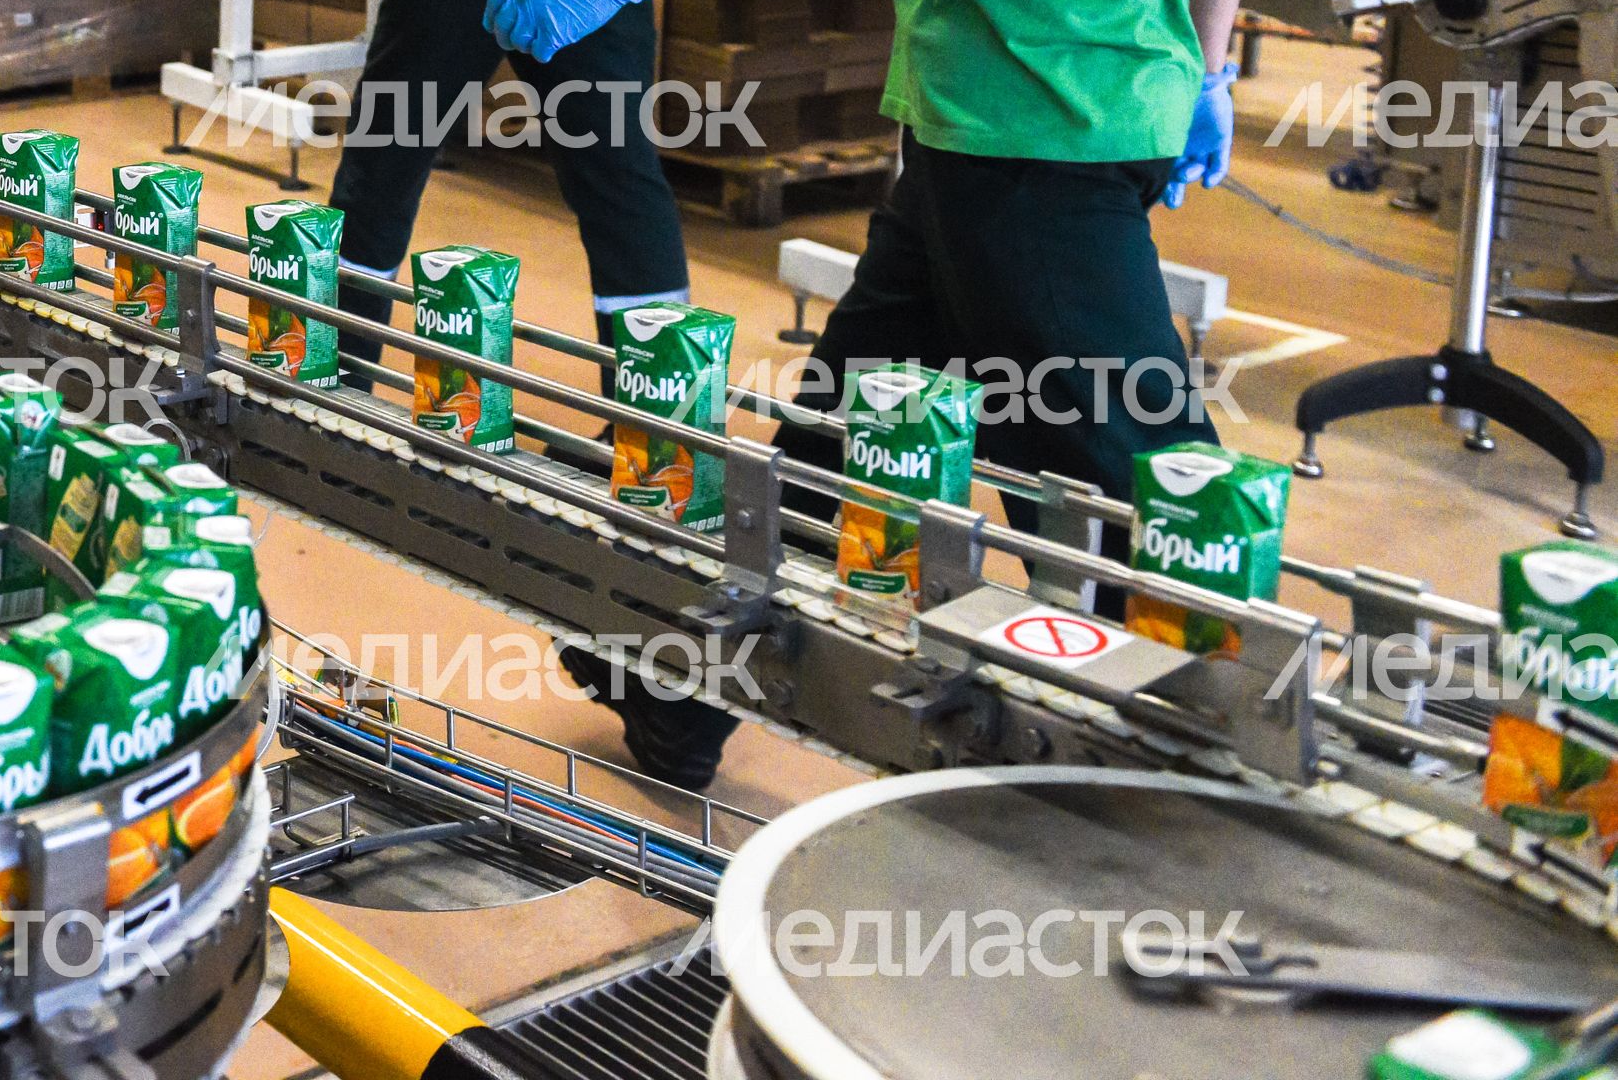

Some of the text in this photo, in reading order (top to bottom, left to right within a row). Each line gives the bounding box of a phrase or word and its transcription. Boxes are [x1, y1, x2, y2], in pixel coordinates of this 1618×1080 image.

[115, 204, 160, 236] брый
[249, 246, 299, 281] брый
[414, 298, 473, 336] брый
[616, 360, 686, 402] брый
[849, 430, 931, 479] брый
[1142, 518, 1240, 574] брый
